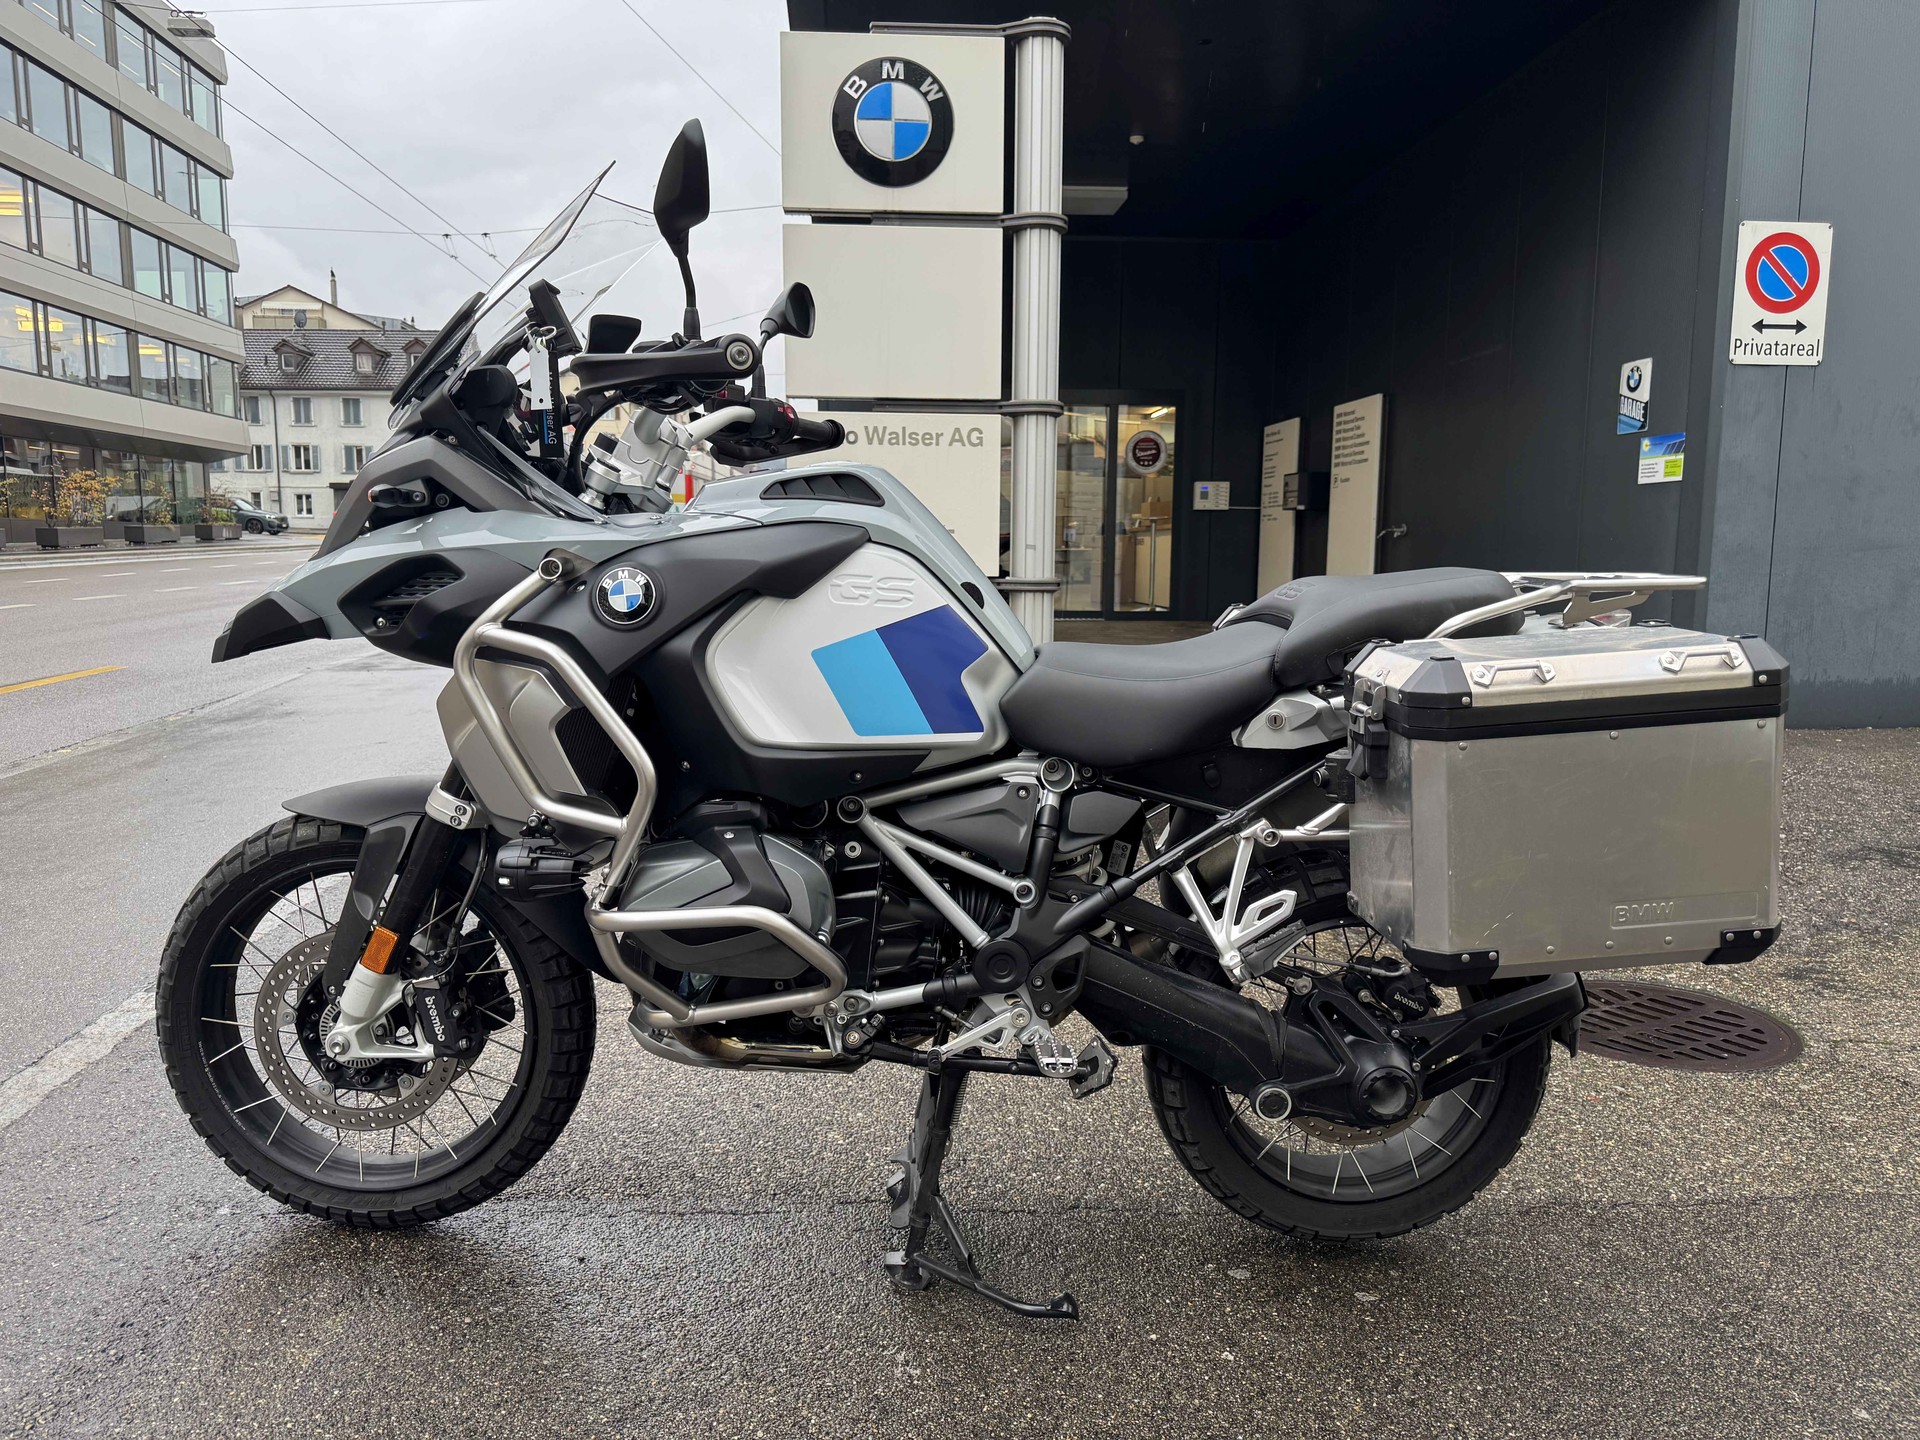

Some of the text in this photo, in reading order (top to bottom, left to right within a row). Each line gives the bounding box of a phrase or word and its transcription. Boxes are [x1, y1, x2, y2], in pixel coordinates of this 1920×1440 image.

[843, 60, 944, 103] BMW
[1733, 337, 1821, 358] Privatareal
[1619, 396, 1646, 422] GARAGE
[548, 430, 558, 445] AG
[864, 425, 944, 447] Walser
[948, 427, 985, 447] AG
[602, 569, 648, 590] BMW
[828, 573, 916, 608] GS
[1614, 901, 1674, 924] BMW
[1393, 991, 1425, 1012] brembo
[424, 995, 446, 1042] brembo
